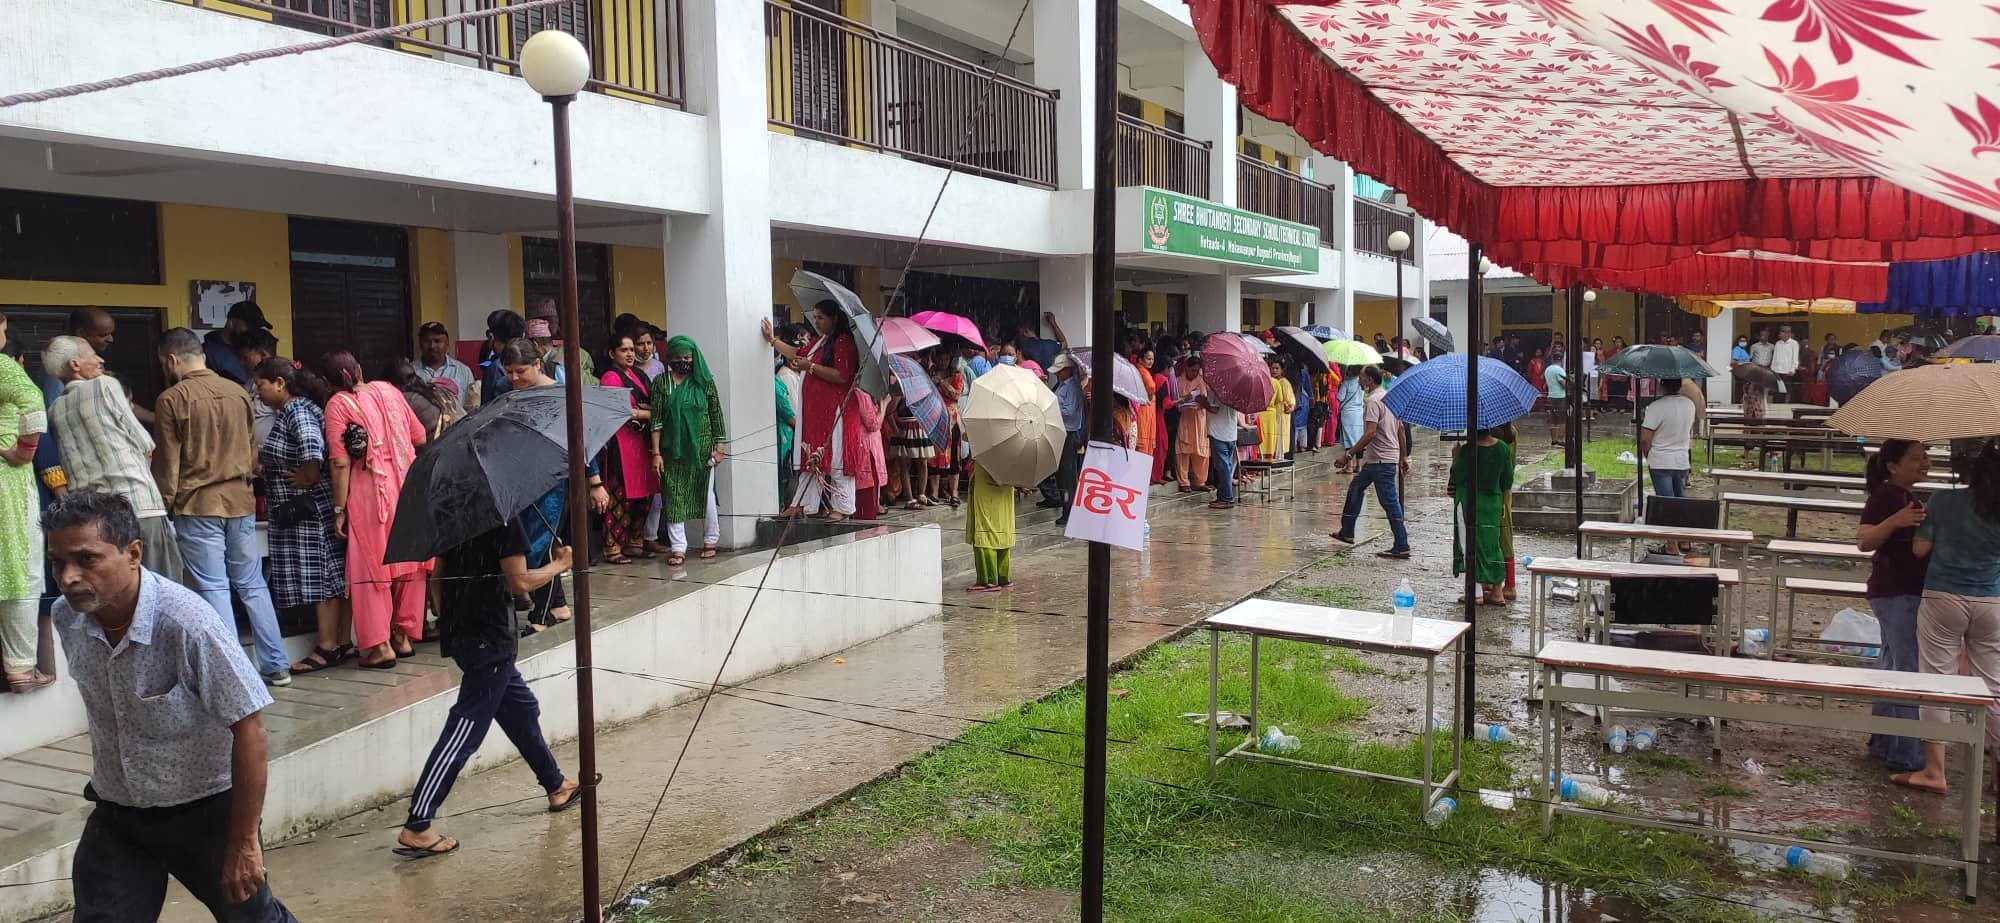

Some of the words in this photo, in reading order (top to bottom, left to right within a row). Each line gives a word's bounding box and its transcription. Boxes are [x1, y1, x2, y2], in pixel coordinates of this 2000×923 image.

[1173, 200, 1194, 225] SHREE
[1233, 214, 1261, 238] SECONDARY
[1301, 230, 1318, 250] SCHOOL
[1075, 467, 1142, 520] हिर
